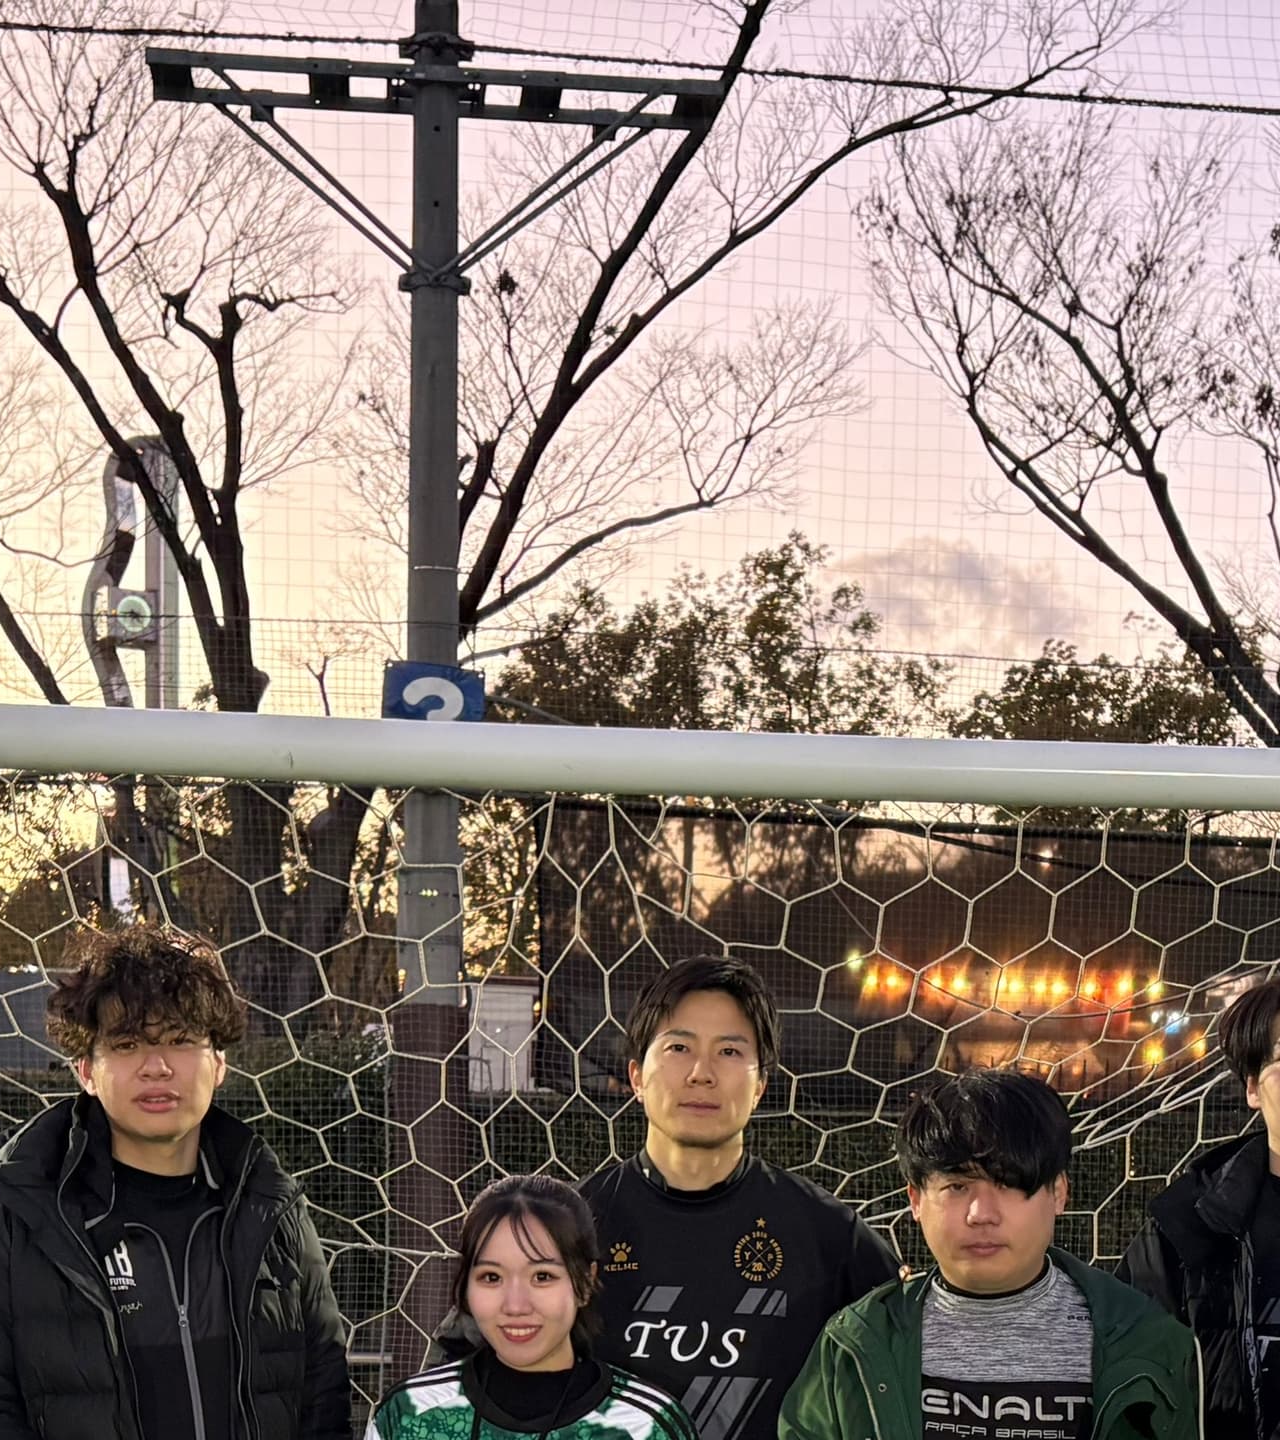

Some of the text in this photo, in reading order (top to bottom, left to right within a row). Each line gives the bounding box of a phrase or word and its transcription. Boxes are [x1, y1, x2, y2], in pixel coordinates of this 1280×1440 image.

[624, 1319, 747, 1368] TUS
[921, 1388, 1094, 1422] ENALT
[925, 1421, 1076, 1440] RAÇA BRASIL
